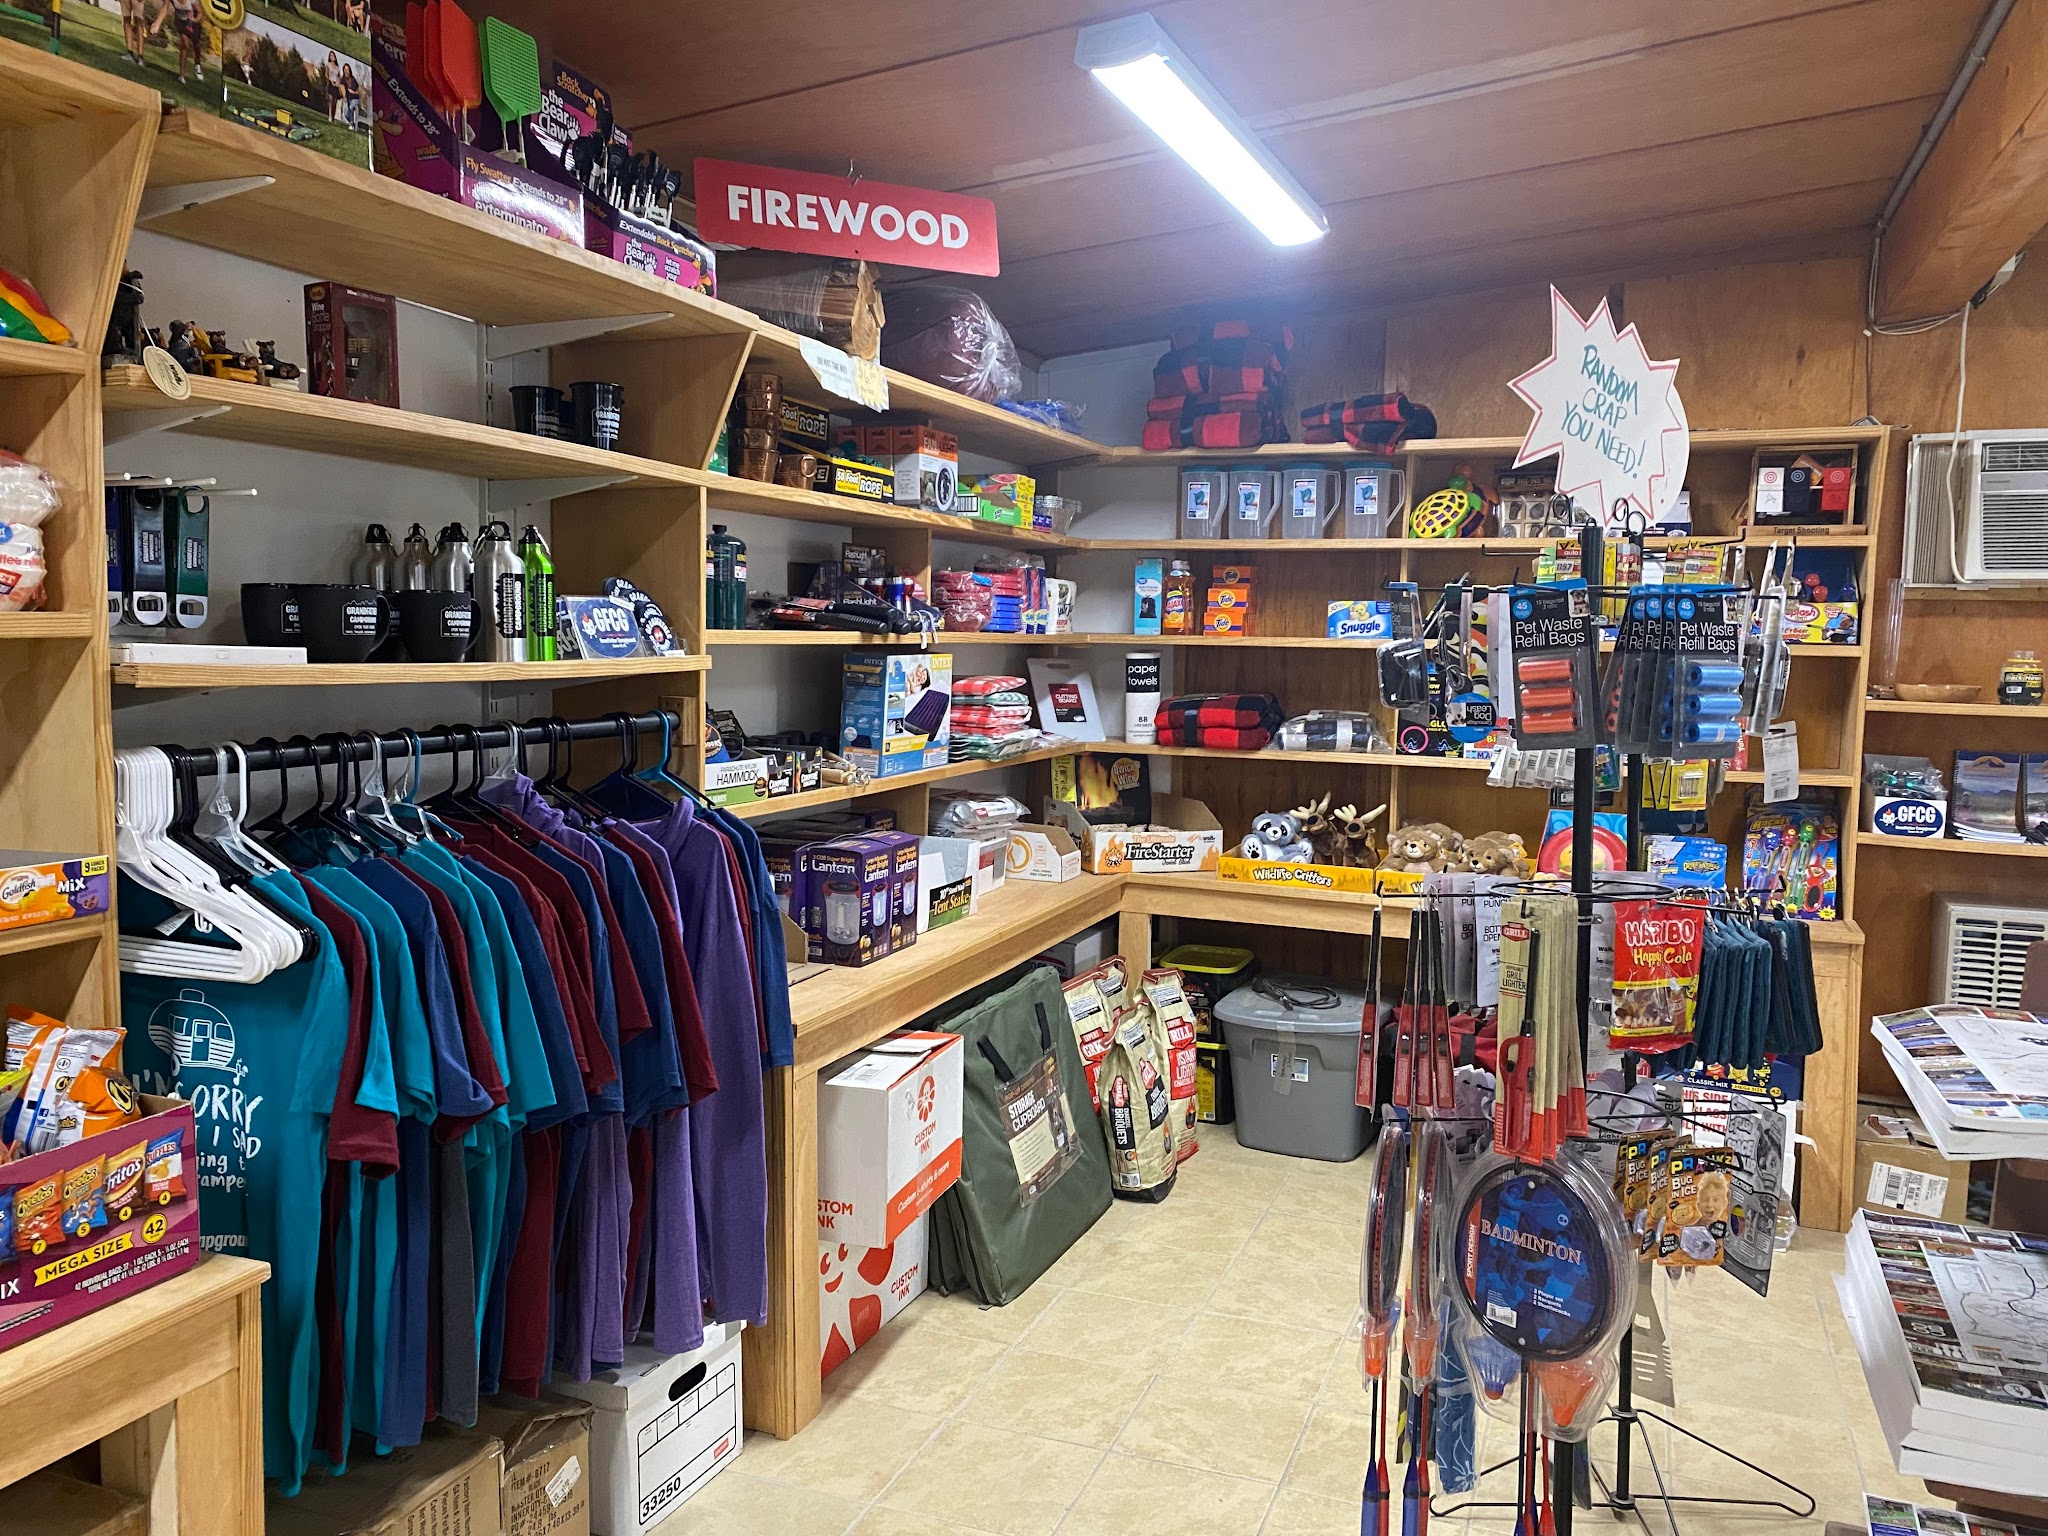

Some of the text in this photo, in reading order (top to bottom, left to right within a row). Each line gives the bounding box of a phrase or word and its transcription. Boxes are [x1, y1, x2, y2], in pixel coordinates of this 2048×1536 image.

[561, 71, 580, 87] Back
[548, 89, 564, 108] the
[541, 94, 569, 125] Bear
[538, 113, 568, 141] Claw
[465, 157, 479, 174] Fly
[480, 163, 512, 184] Swatter
[512, 177, 546, 198] Extends
[546, 192, 555, 201] to
[475, 200, 549, 236] exterminator
[727, 184, 969, 249] FIREWOOD
[619, 220, 656, 242] Extendable
[625, 243, 645, 260] Bear
[631, 238, 643, 249] the
[623, 255, 645, 271] Claw
[1580, 344, 1638, 415] RANDOM
[1582, 388, 1628, 429] CRAP
[799, 417, 826, 435] ROPE
[1561, 400, 1647, 479] YOU NEED!
[859, 479, 882, 495] ROPE
[1773, 526, 1830, 536] Target Shooting
[1224, 571, 1239, 581] Tide
[503, 577, 513, 634] GRANDFATHER
[514, 580, 523, 631] CAMPGROUND
[1219, 594, 1234, 605] Tide
[1516, 602, 1528, 610] 45
[1683, 601, 1694, 610] 45
[593, 608, 630, 632] GFCG
[1215, 618, 1230, 628] Tide
[1340, 620, 1381, 635] Snuggle
[1516, 618, 1583, 635] Pet Waste
[1680, 622, 1735, 636] Pet Waste
[1515, 631, 1586, 649] Refill Bags
[1679, 636, 1736, 653] Refill Bags
[863, 658, 884, 666] INTEX
[932, 658, 951, 669] INTEX
[1128, 665, 1158, 675] paper
[1128, 676, 1158, 686] towels
[1466, 705, 1492, 713] Leash
[1473, 712, 1492, 720] Dog
[716, 769, 759, 786] HAMMOCK
[1898, 805, 1936, 823] GFCG
[1133, 835, 1176, 843] The Ultimate
[1126, 843, 1194, 859] FireStarter
[84, 862, 91, 873] 9
[812, 860, 855, 873] Lantern
[895, 860, 917, 873] Lantern
[865, 868, 889, 883] Lantern
[1253, 868, 1332, 887] Wildlife Critters
[2, 879, 36, 900] Goldfish
[932, 898, 949, 916] Tent
[1503, 927, 1527, 937] GRILL
[1625, 918, 1695, 947] HARIBO
[1634, 947, 1692, 967] Happy Cola
[1506, 970, 1522, 981] GRILL
[1502, 978, 1526, 990] LIGHTER
[1170, 1025, 1193, 1041] RILL
[1687, 1077, 1715, 1087] CLASSIC
[1008, 1090, 1035, 1119] STORAGE
[1012, 1097, 1046, 1132] CUPBOARD
[914, 1120, 937, 1146] CUSTOM
[1114, 1108, 1128, 1145] BRIQUETS
[146, 1142, 176, 1165] RUFFLES
[920, 1140, 931, 1155] INK
[105, 1158, 142, 1194] Fritos
[1628, 1161, 1646, 1175] BUG
[63, 1166, 98, 1199] Cheetos
[1635, 1172, 1649, 1184] ICE
[1651, 1169, 1666, 1184] BUG
[1656, 1177, 1668, 1191] ICE
[1672, 1177, 1693, 1190] BUG
[161, 1194, 168, 1203] 4
[1671, 1186, 1697, 1199] IN ICE
[16, 1184, 54, 1218] Cheetos
[122, 1209, 129, 1218] 4
[144, 1219, 165, 1236] 42
[1480, 1219, 1582, 1266] BADMINTON
[44, 1254, 90, 1280] MEGA
[93, 1238, 124, 1258] SIZE
[1466, 1224, 1476, 1278] SPORT DESIGN
[891, 1263, 918, 1294] CUSTOM
[898, 1285, 910, 1301] INK
[511, 1496, 534, 1513] MASTER
[642, 1477, 681, 1517] 33250
[511, 1509, 530, 1524] INNER
